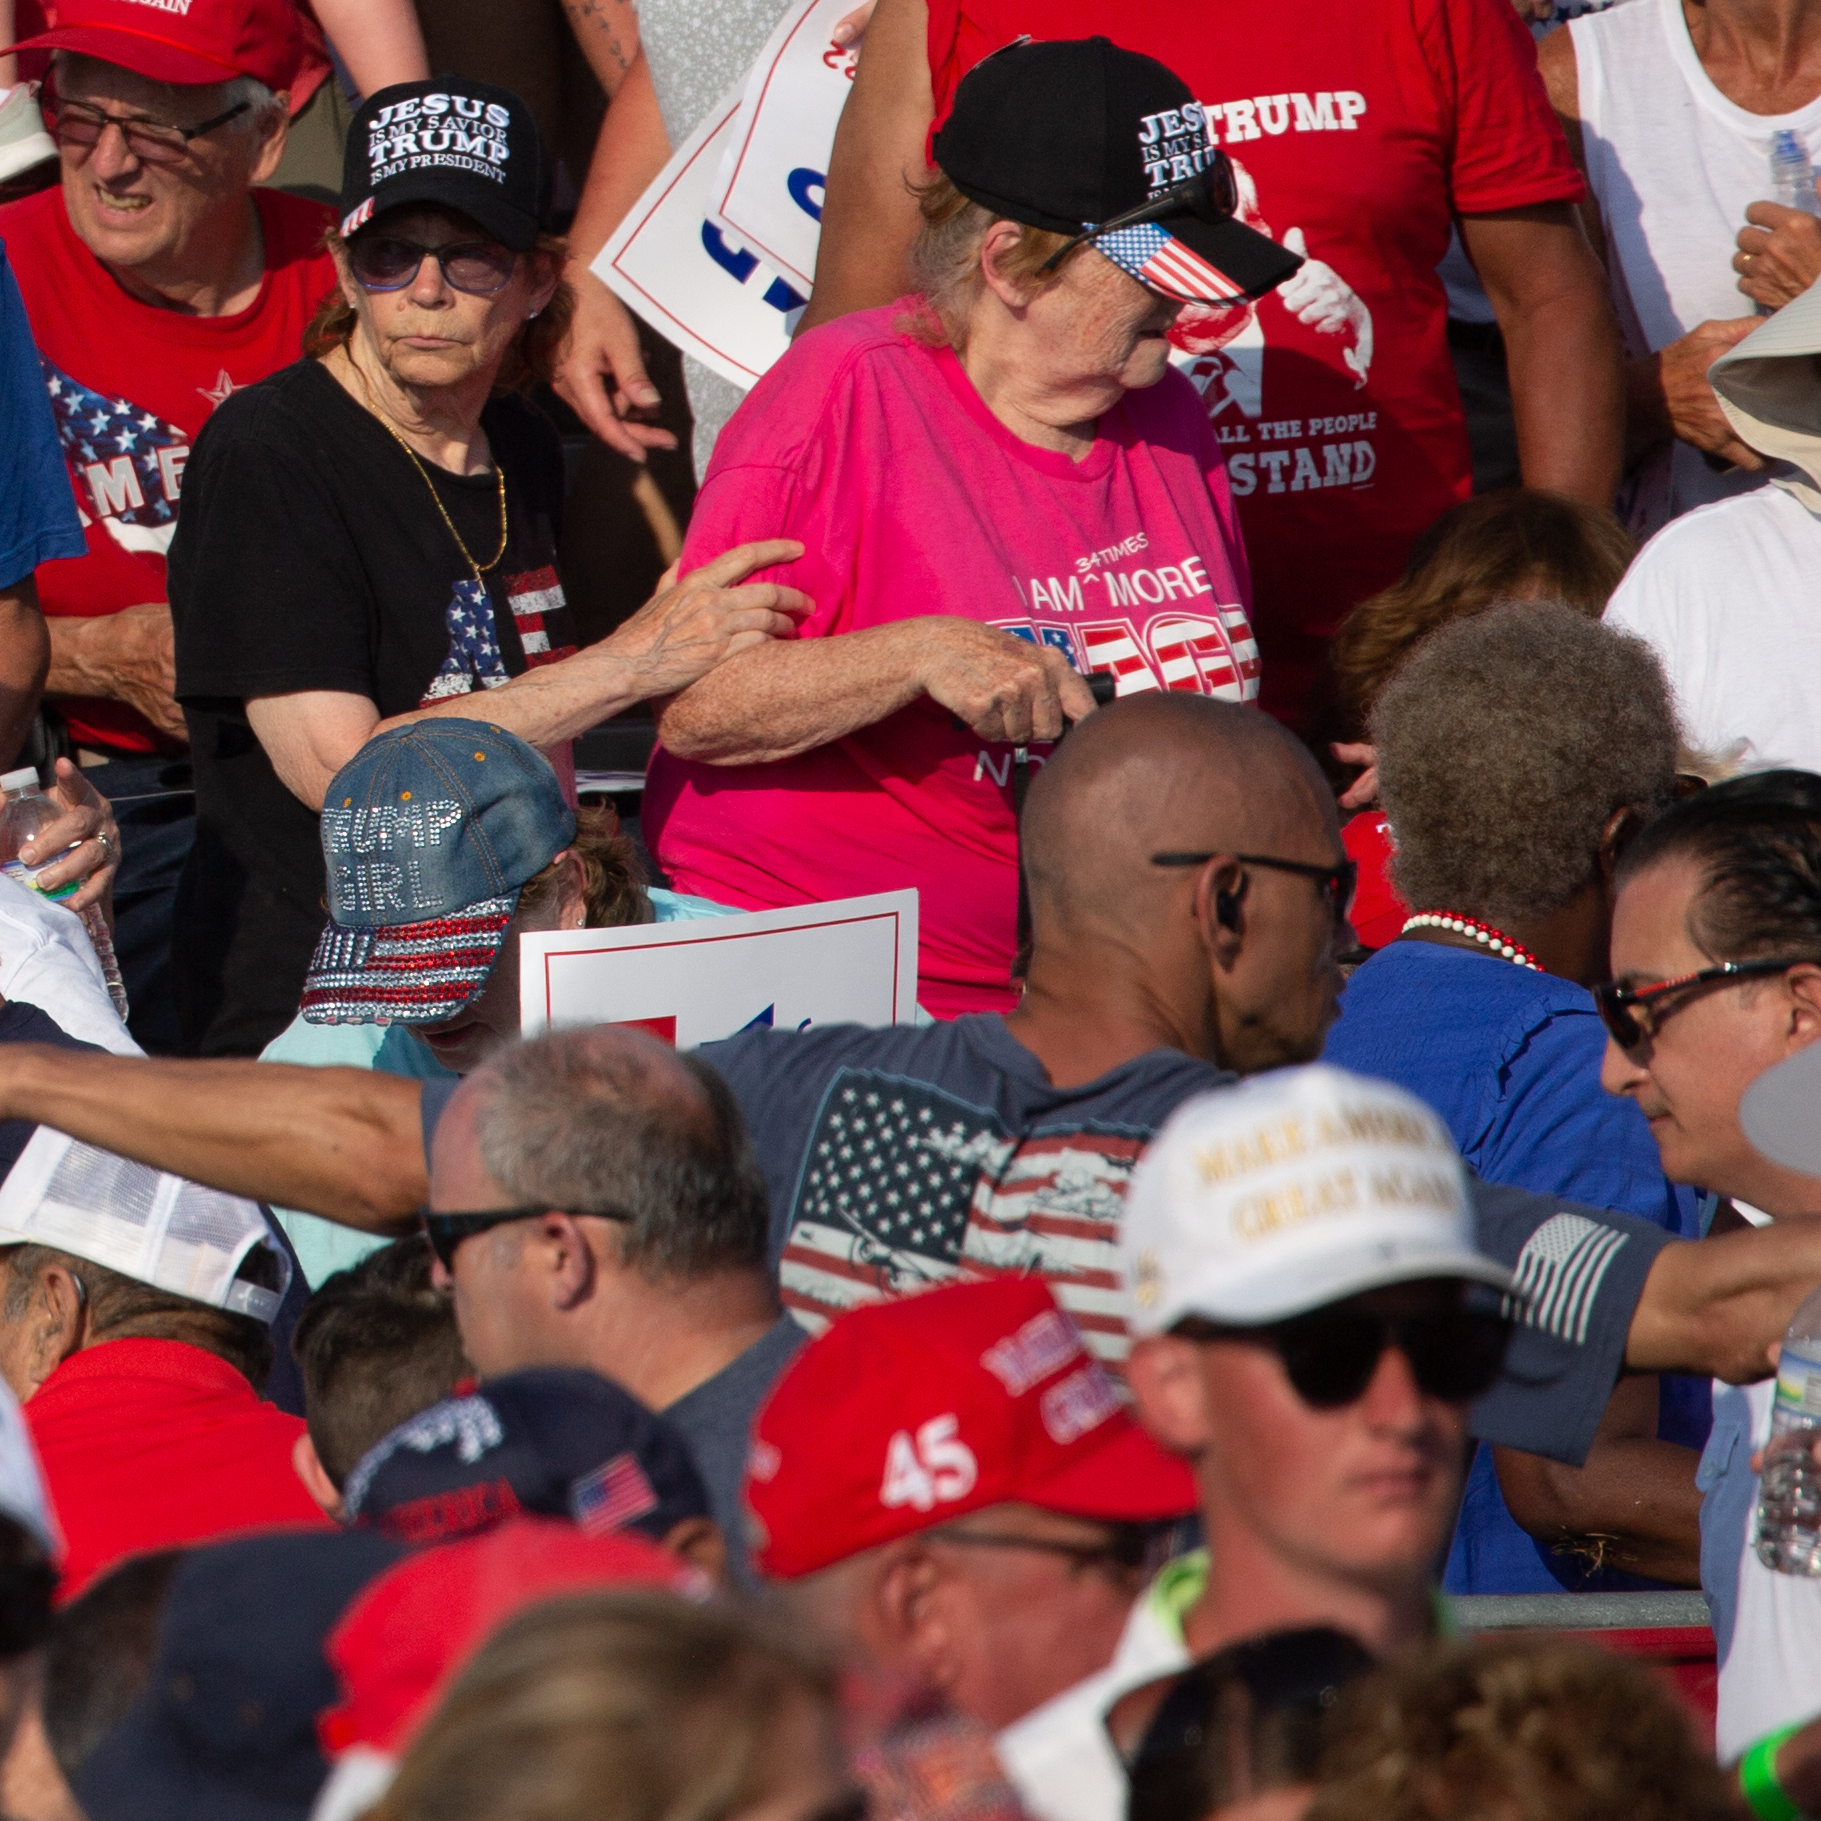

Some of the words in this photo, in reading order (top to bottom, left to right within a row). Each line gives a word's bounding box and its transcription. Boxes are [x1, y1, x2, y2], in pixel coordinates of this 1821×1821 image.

[369, 93, 510, 130] JESUS
[369, 129, 386, 146] IS
[388, 118, 424, 139] MY
[427, 115, 508, 146] SAVIOR
[1204, 90, 1367, 145] TRUMP
[368, 129, 510, 169] TRUMP
[370, 168, 383, 186] IS
[383, 158, 408, 178] MY
[409, 153, 506, 185] PRESIDENT
[1142, 145, 1161, 163] IS
[1163, 135, 1192, 157] MY
[1258, 420, 1302, 441] THE
[1309, 412, 1378, 436] PEOPLE
[1229, 439, 1376, 496] STAND
[1030, 575, 1085, 612] AM
[1103, 555, 1212, 607] MORE
[322, 799, 462, 855] TRUMP
[333, 860, 444, 912] GIRL
[878, 1413, 979, 1513] 45
